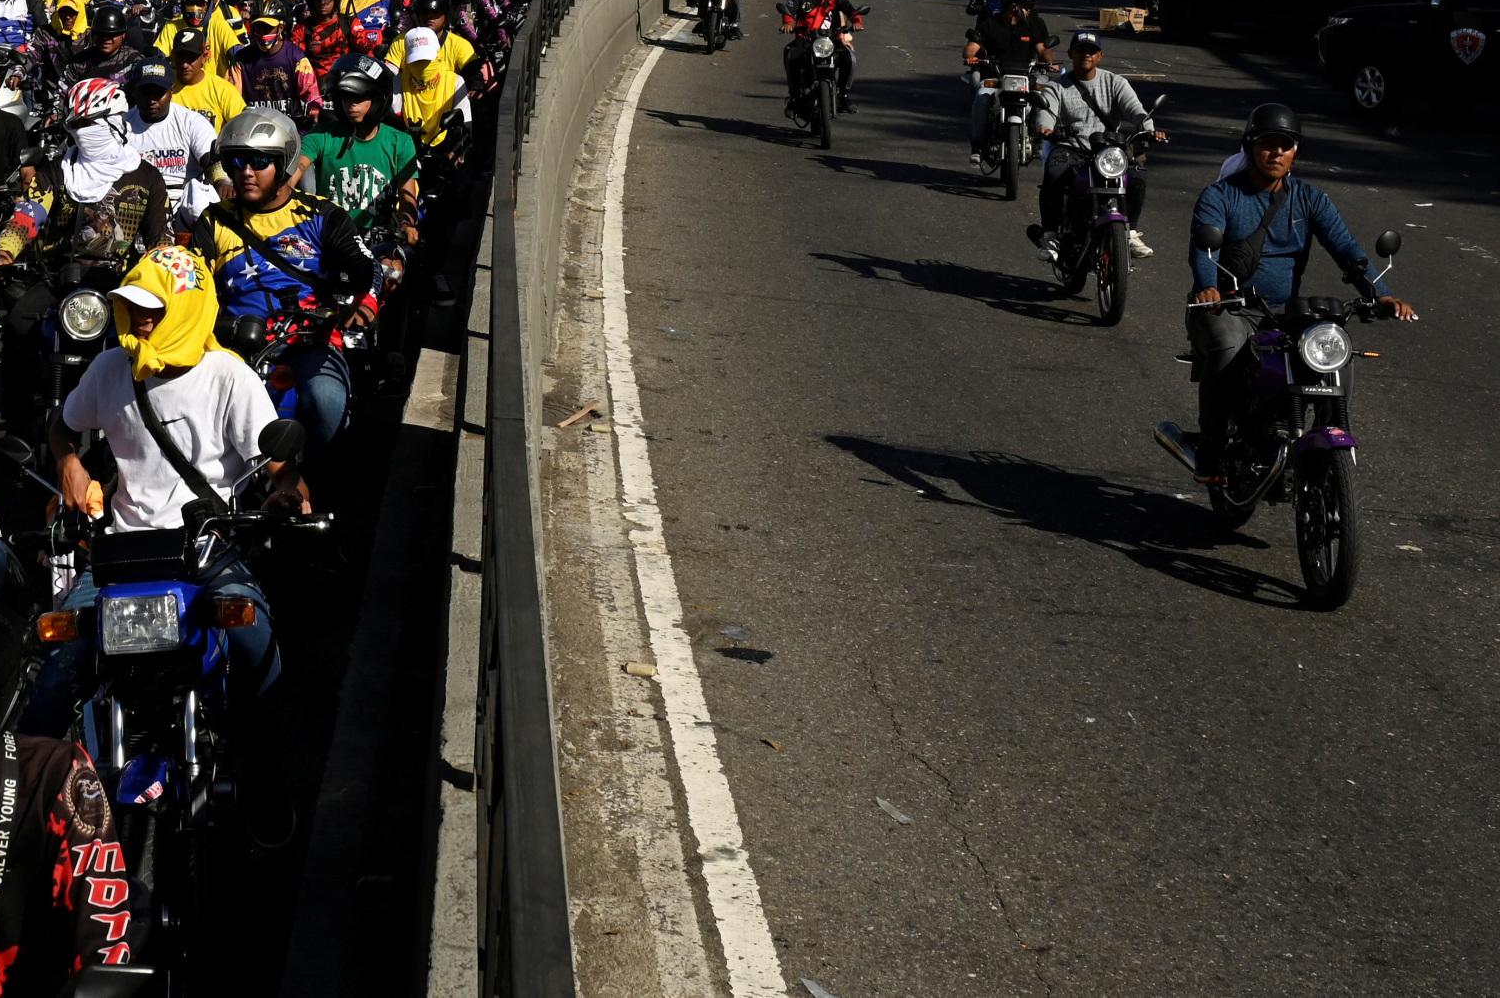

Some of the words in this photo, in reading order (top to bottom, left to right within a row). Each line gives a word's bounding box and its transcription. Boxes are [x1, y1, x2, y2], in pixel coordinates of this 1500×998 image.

[156, 148, 185, 158] JURO
[154, 157, 186, 168] MADURO
[0, 778, 17, 826] YOUNG
